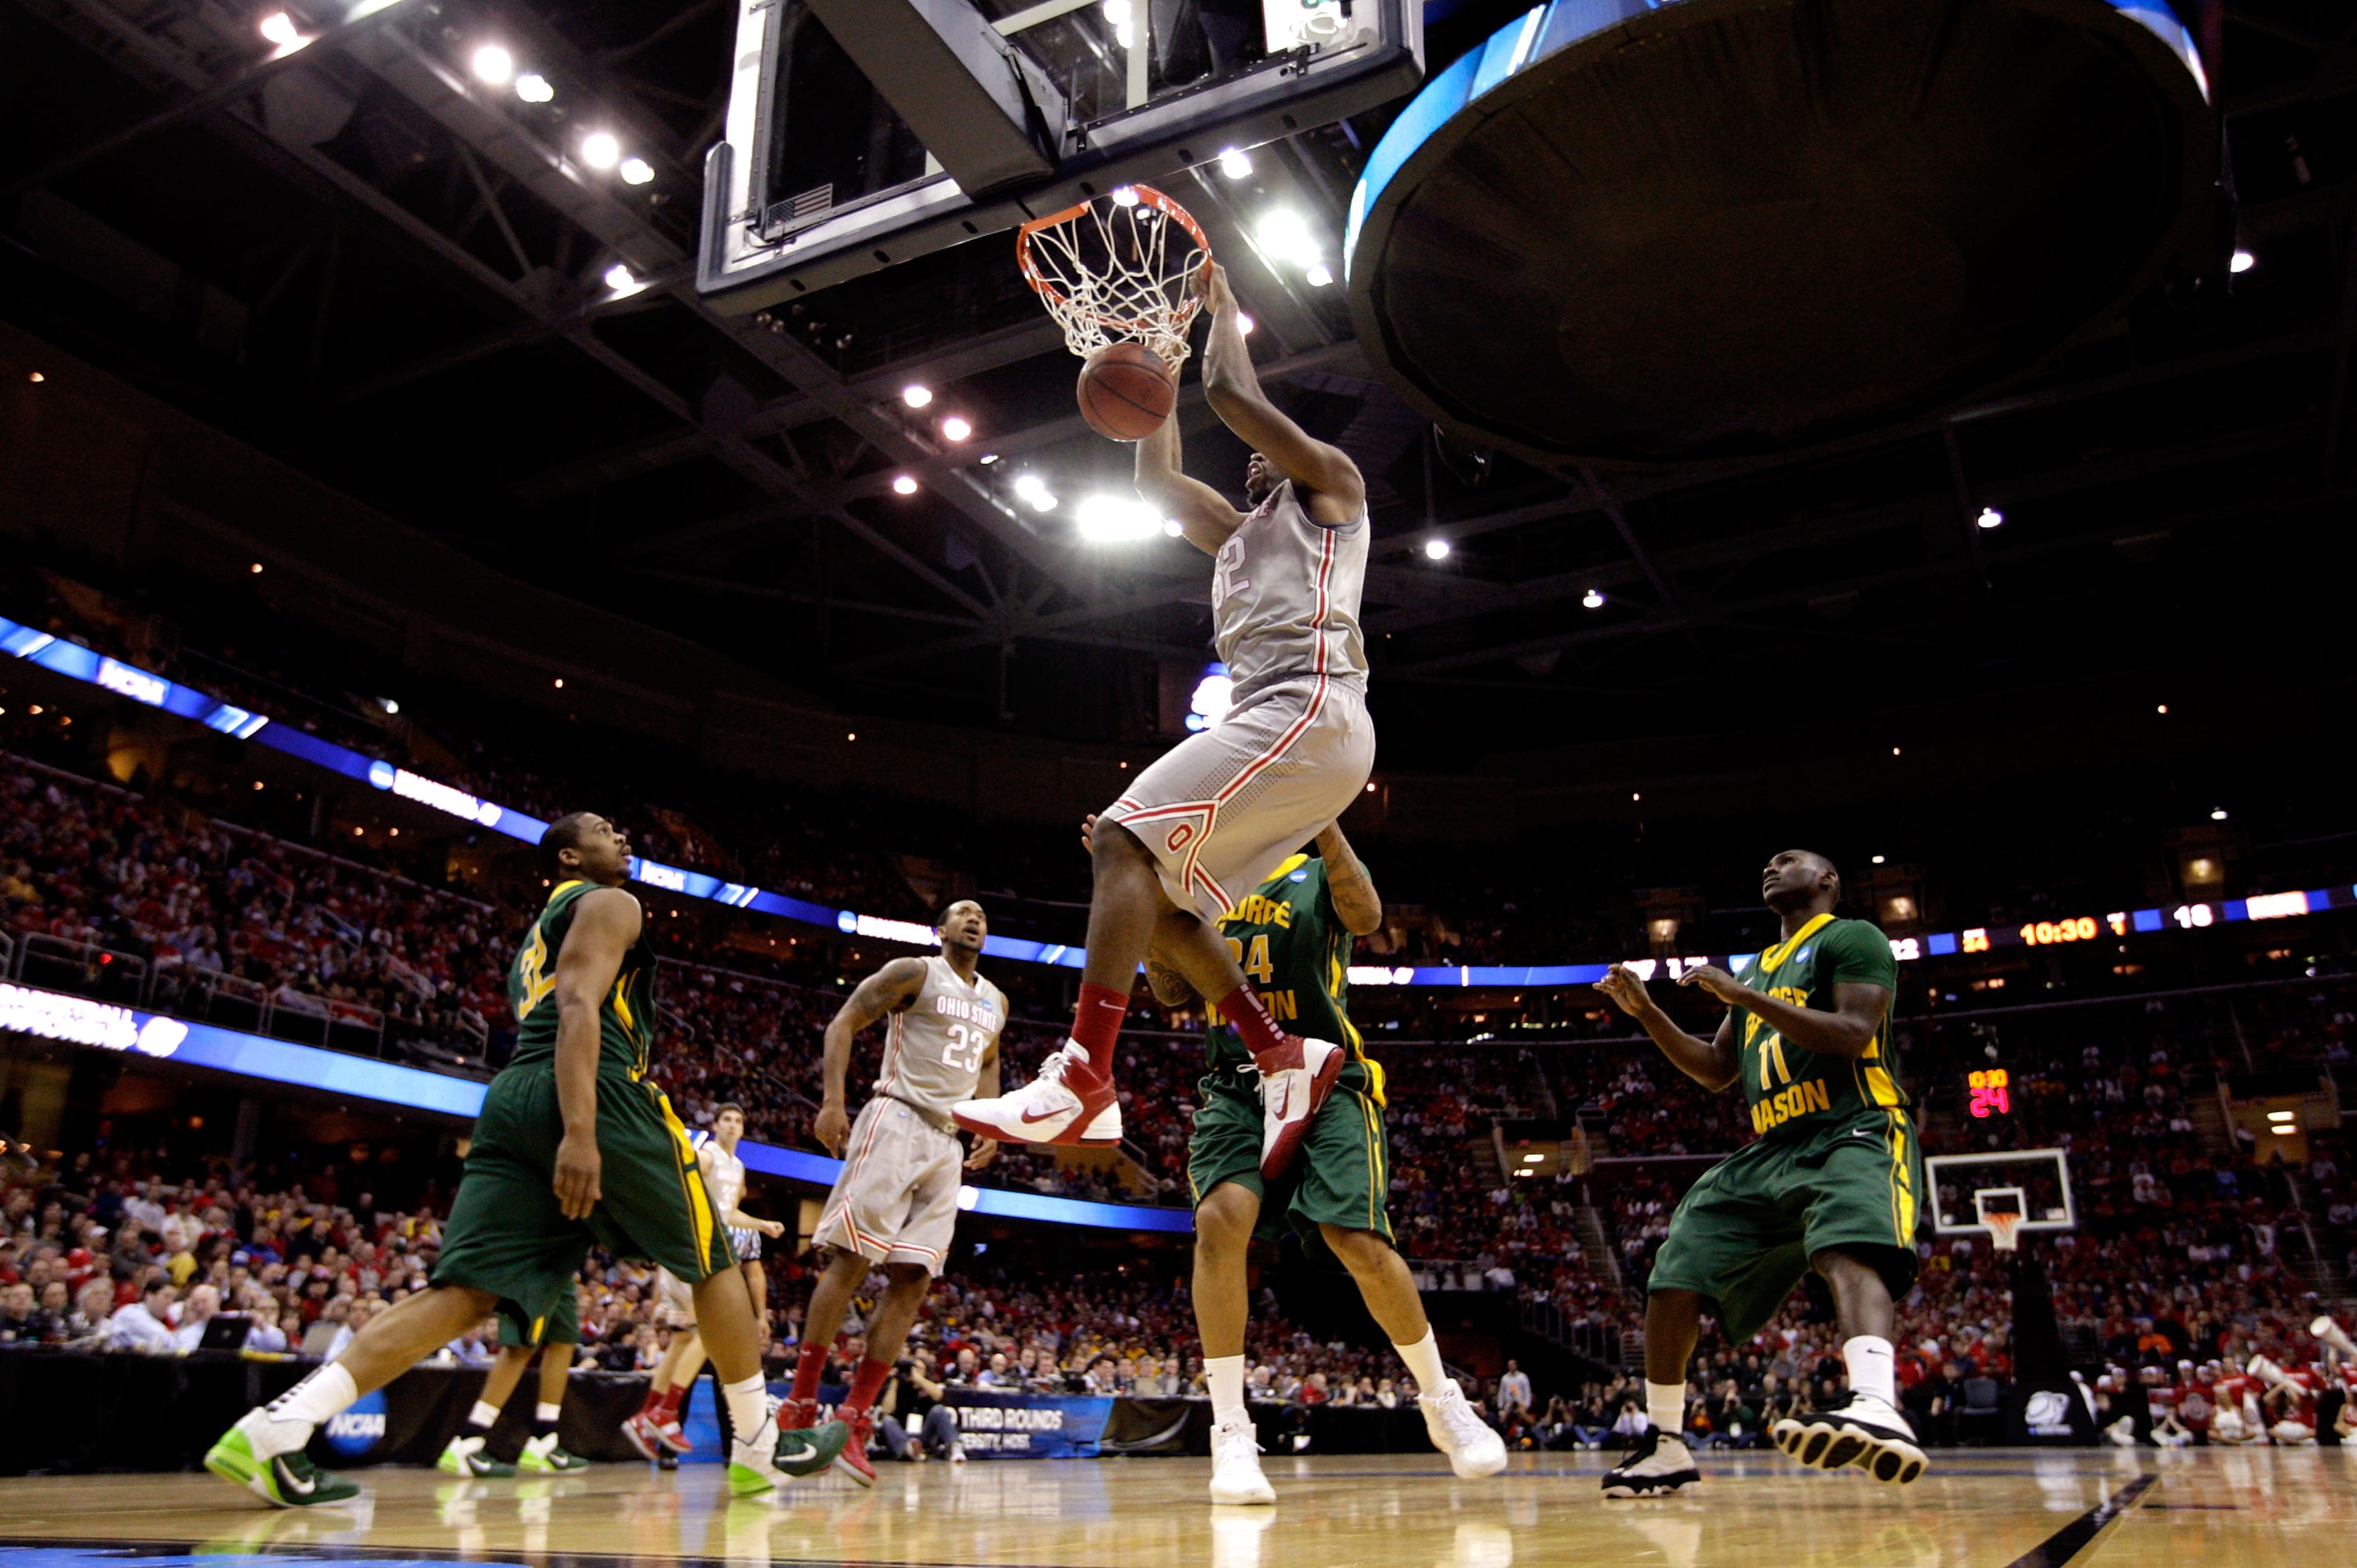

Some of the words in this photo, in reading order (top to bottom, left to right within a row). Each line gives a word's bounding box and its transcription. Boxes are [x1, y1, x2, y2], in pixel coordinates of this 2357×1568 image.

[2019, 916, 2098, 946] 10:30
[937, 995, 969, 1019] OHIO
[971, 1005, 997, 1033] STATE
[942, 1023, 983, 1073] 23
[1759, 1032, 1792, 1091] 11
[1970, 1088, 2009, 1118] 24
[325, 1413, 386, 1438] NCAA
[958, 1406, 1004, 1429] THIRD
[1004, 1407, 1063, 1431] ROUNDS
